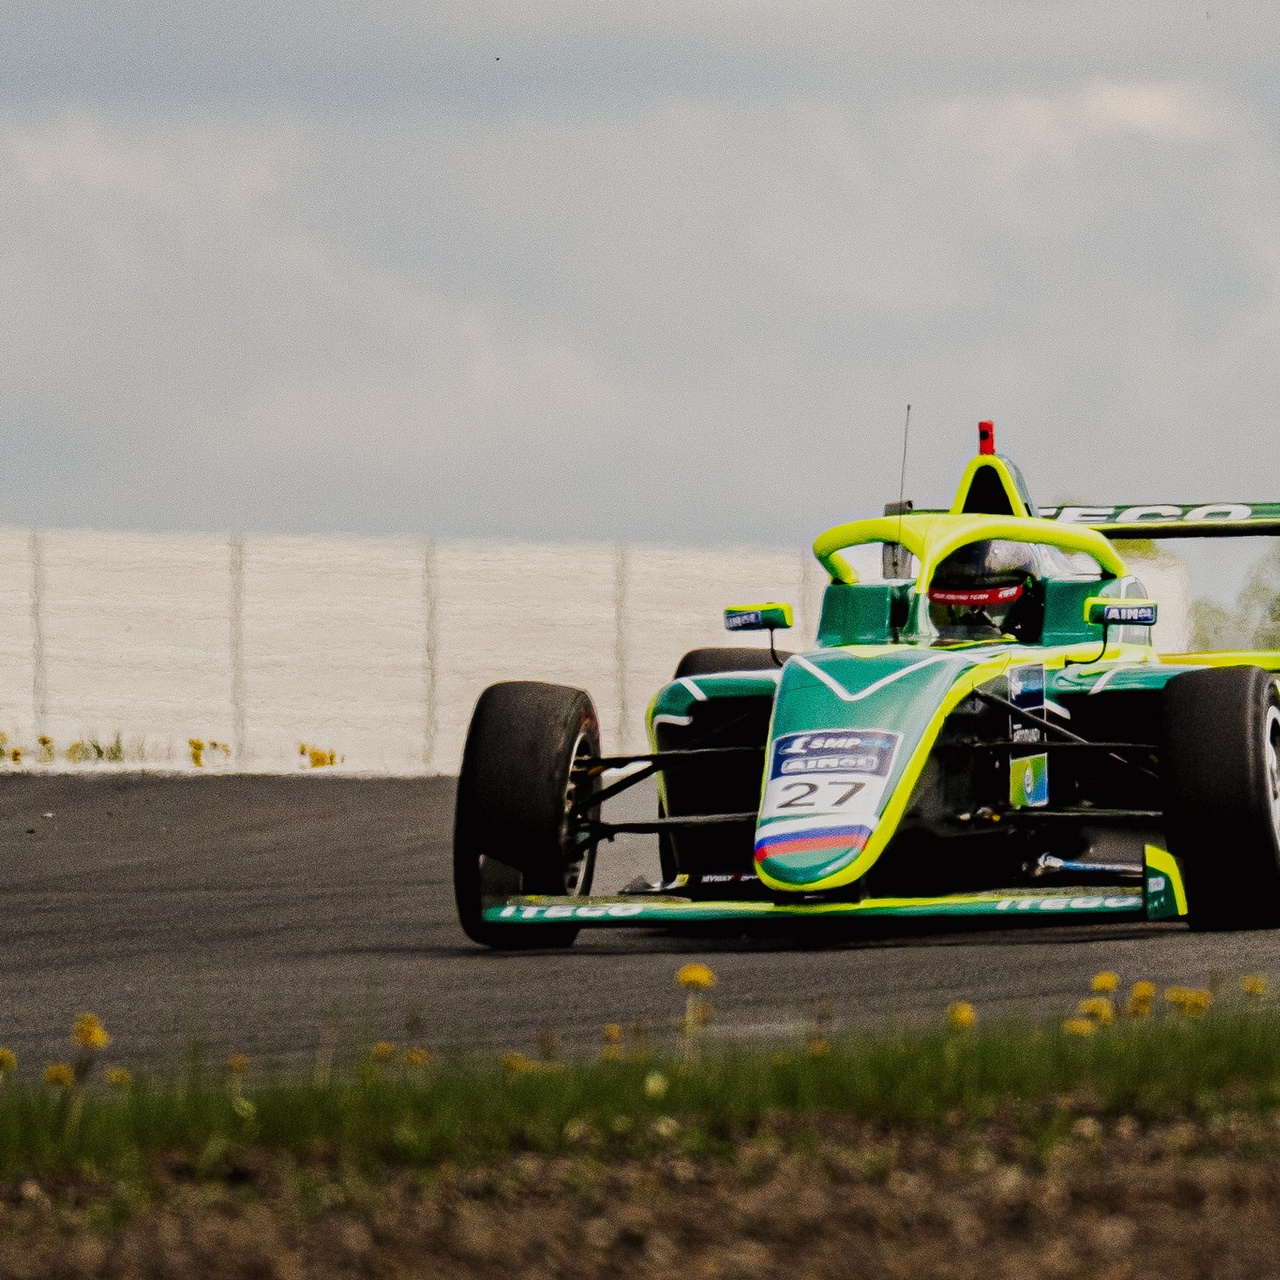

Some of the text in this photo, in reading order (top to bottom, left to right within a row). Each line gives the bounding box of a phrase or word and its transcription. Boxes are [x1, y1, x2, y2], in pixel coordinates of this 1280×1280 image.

[810, 737, 861, 749] SMP
[777, 782, 866, 809] 27
[500, 905, 644, 918] ITECO
